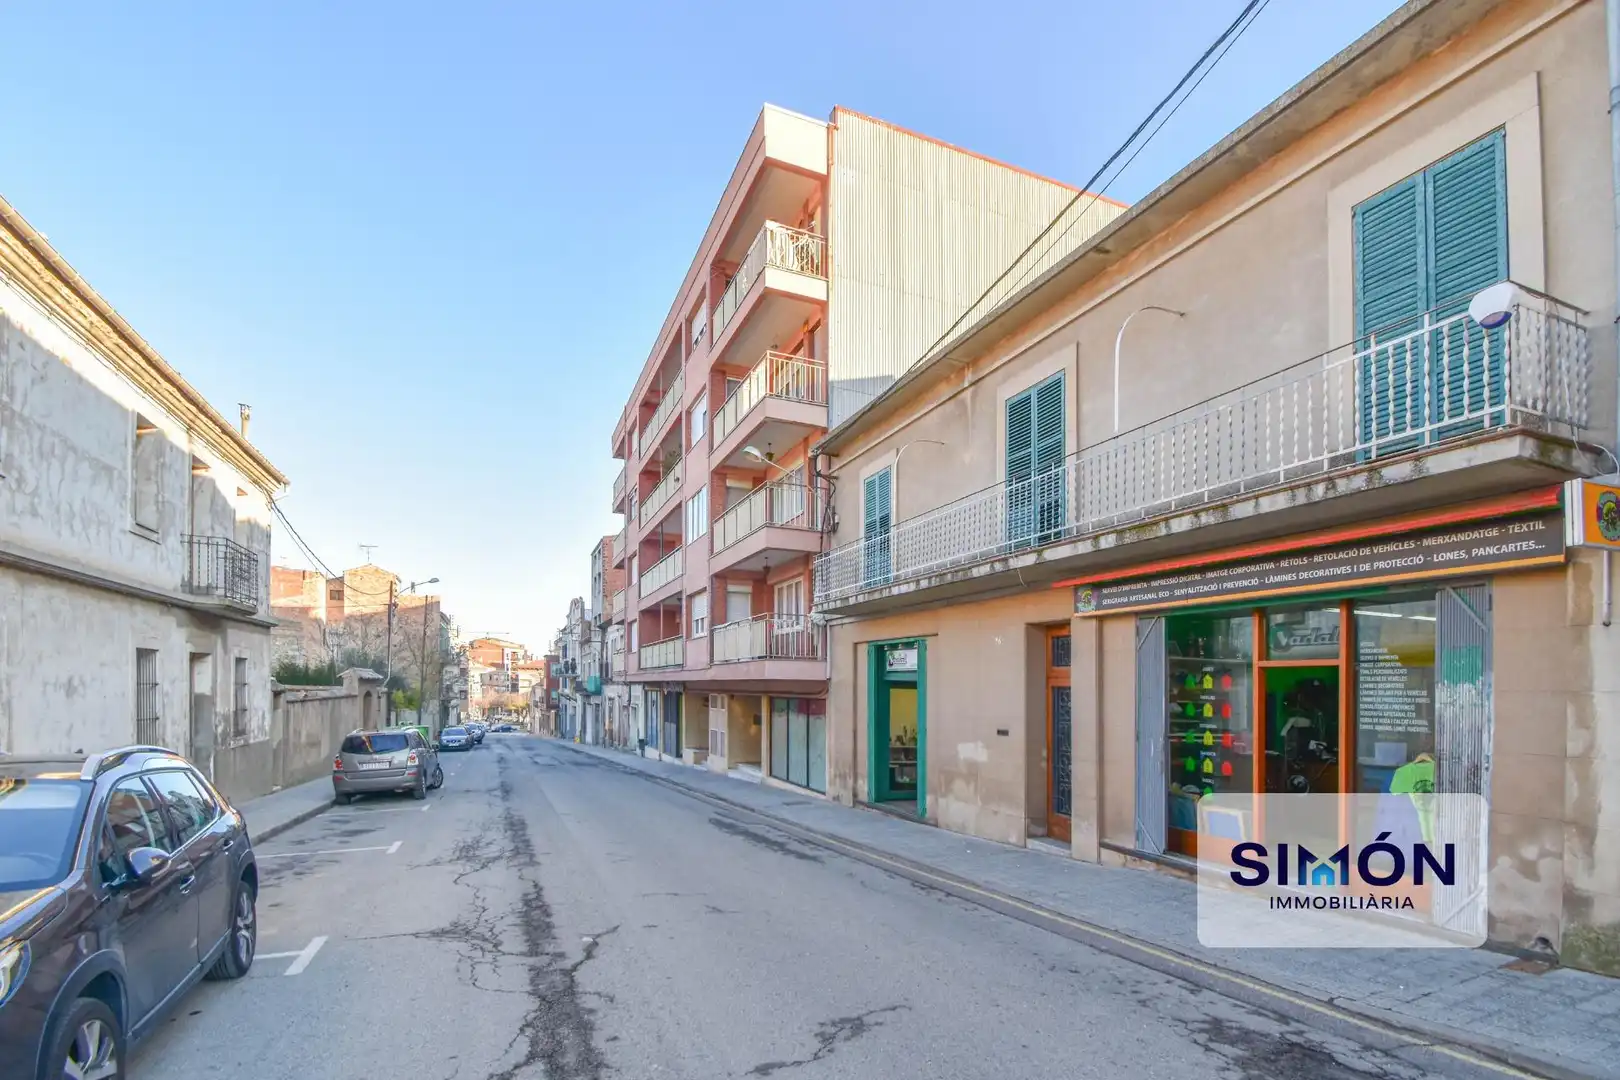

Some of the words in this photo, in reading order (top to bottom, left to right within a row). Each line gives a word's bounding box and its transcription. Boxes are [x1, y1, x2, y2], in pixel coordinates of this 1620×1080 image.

[1102, 596, 1128, 606] SERIGRAFIA
[1129, 592, 1157, 602] ARTESANAL
[1158, 590, 1169, 598] ECO
[1174, 583, 1217, 596] SENYALITZACIÓ
[1223, 577, 1258, 589] PREVENCIÓ
[1265, 573, 1297, 584] LÀMINES
[1298, 565, 1352, 579] DECORATIVES
[1359, 562, 1371, 572] DE
[1373, 555, 1424, 570] PROTECCIÓ
[1433, 548, 1469, 563] LONES,
[1151, 576, 1178, 588] IMPRESSIÓ
[1179, 574, 1201, 583] DIGITAL
[1206, 569, 1228, 578] IMATGE
[1229, 561, 1275, 575] CORPORATIVA
[1313, 549, 1358, 563] RETOLACIÓ
[1359, 547, 1371, 556] DE
[1422, 527, 1499, 546] MERXANDATGE
[1508, 520, 1546, 534] TÈXTIL
